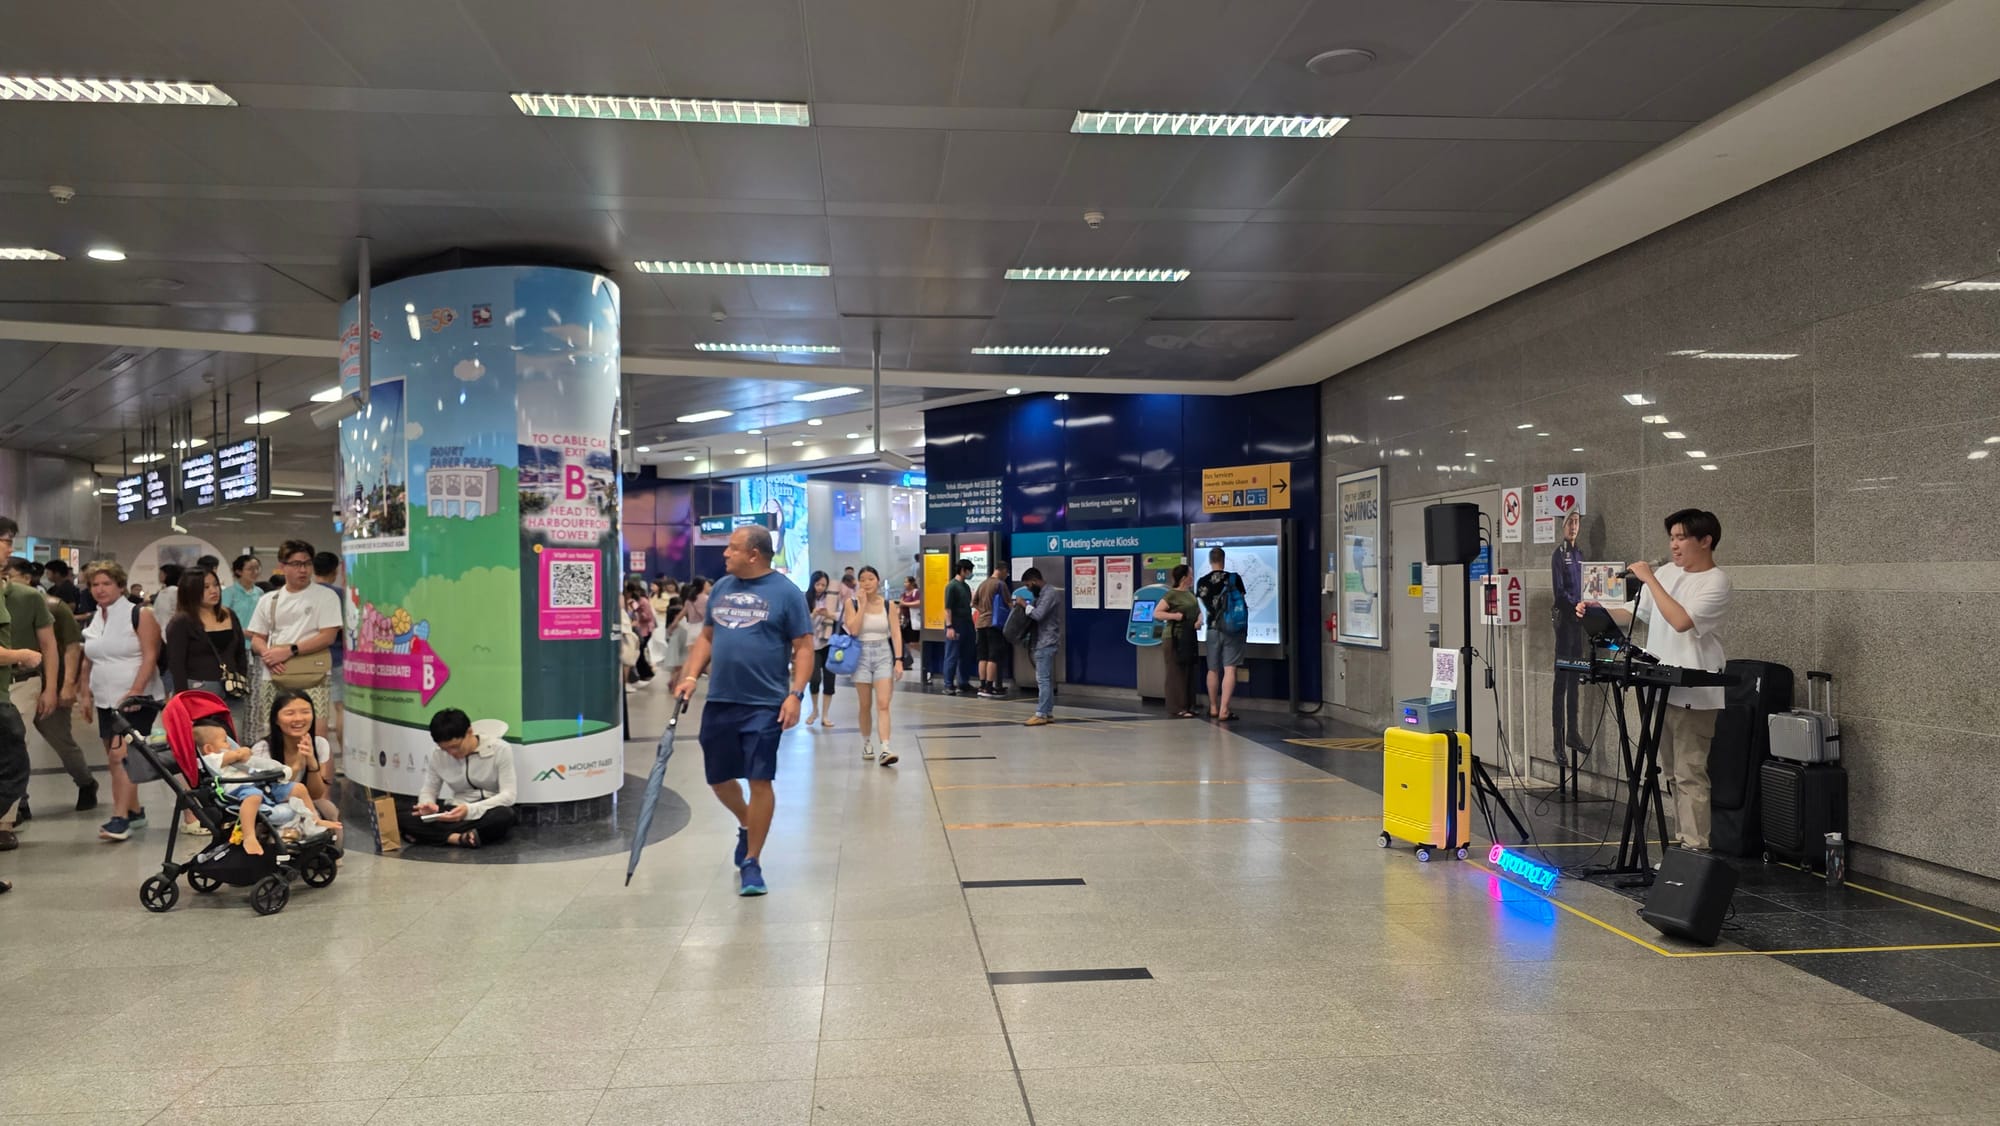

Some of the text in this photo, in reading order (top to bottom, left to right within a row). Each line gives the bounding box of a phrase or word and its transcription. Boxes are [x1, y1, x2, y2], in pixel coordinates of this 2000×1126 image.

[533, 434, 549, 444] TO
[553, 435, 588, 447] CABLE
[565, 448, 586, 457] EXIT
[565, 464, 587, 500] B
[1552, 477, 1579, 487] AED
[550, 506, 597, 518] HEAD TO
[1344, 499, 1378, 522] SAVINGS
[528, 517, 609, 530] HARBOURFRONT
[551, 530, 588, 541] TOWER
[1062, 536, 1139, 550] Ticketing Service Kiosks
[1156, 572, 1166, 581] 04
[1074, 586, 1097, 596] SMRT
[1507, 576, 1522, 623] AED
[422, 663, 436, 691] B
[569, 761, 598, 771] MOUNT
